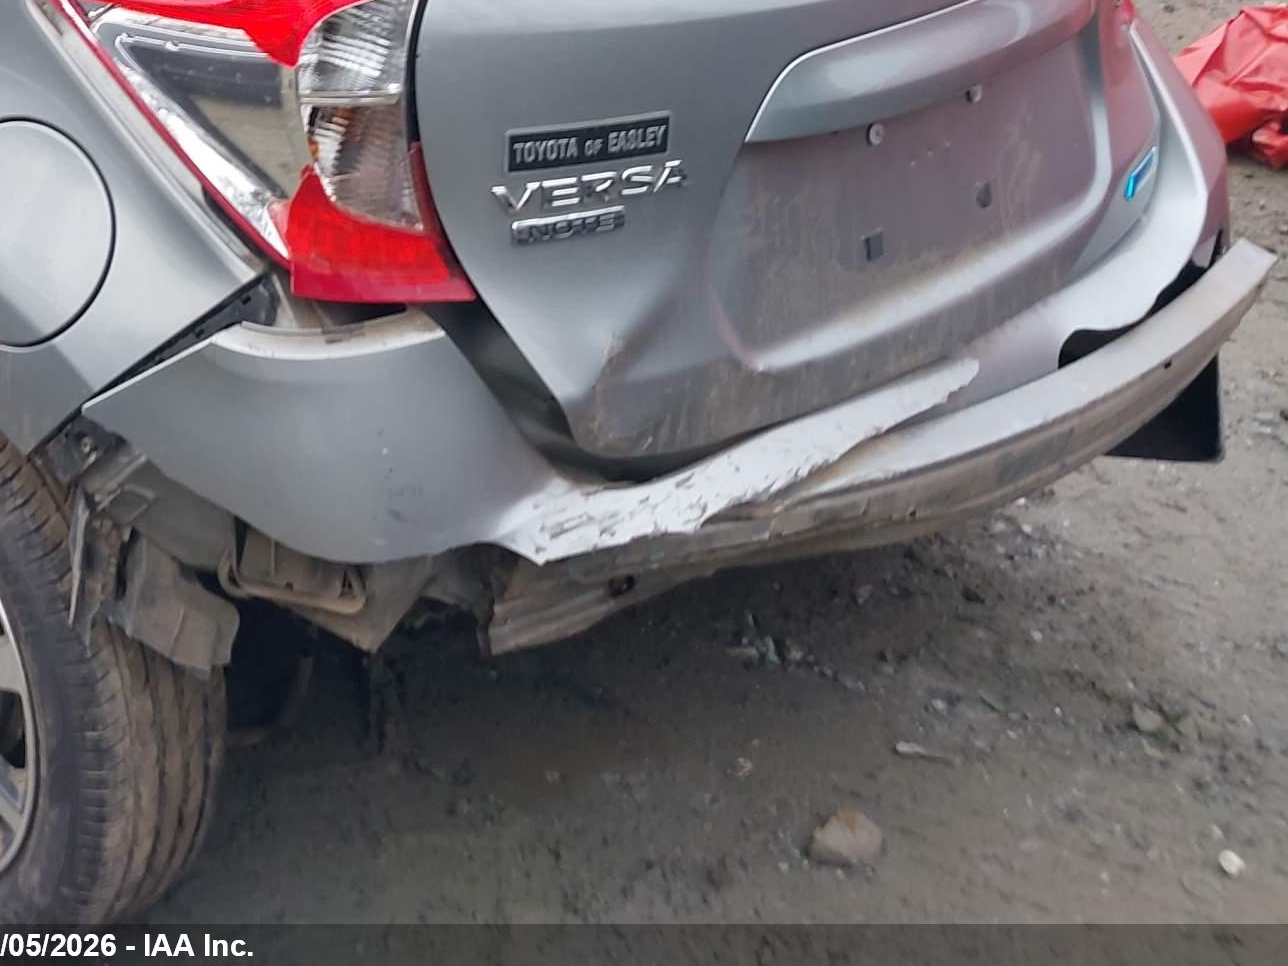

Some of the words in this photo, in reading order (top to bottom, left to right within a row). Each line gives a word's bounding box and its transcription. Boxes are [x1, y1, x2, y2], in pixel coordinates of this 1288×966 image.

[512, 136, 579, 165] TOYOTA
[607, 123, 668, 154] EASLEY
[489, 158, 687, 213] VERSA
[524, 211, 620, 243] NOTE
